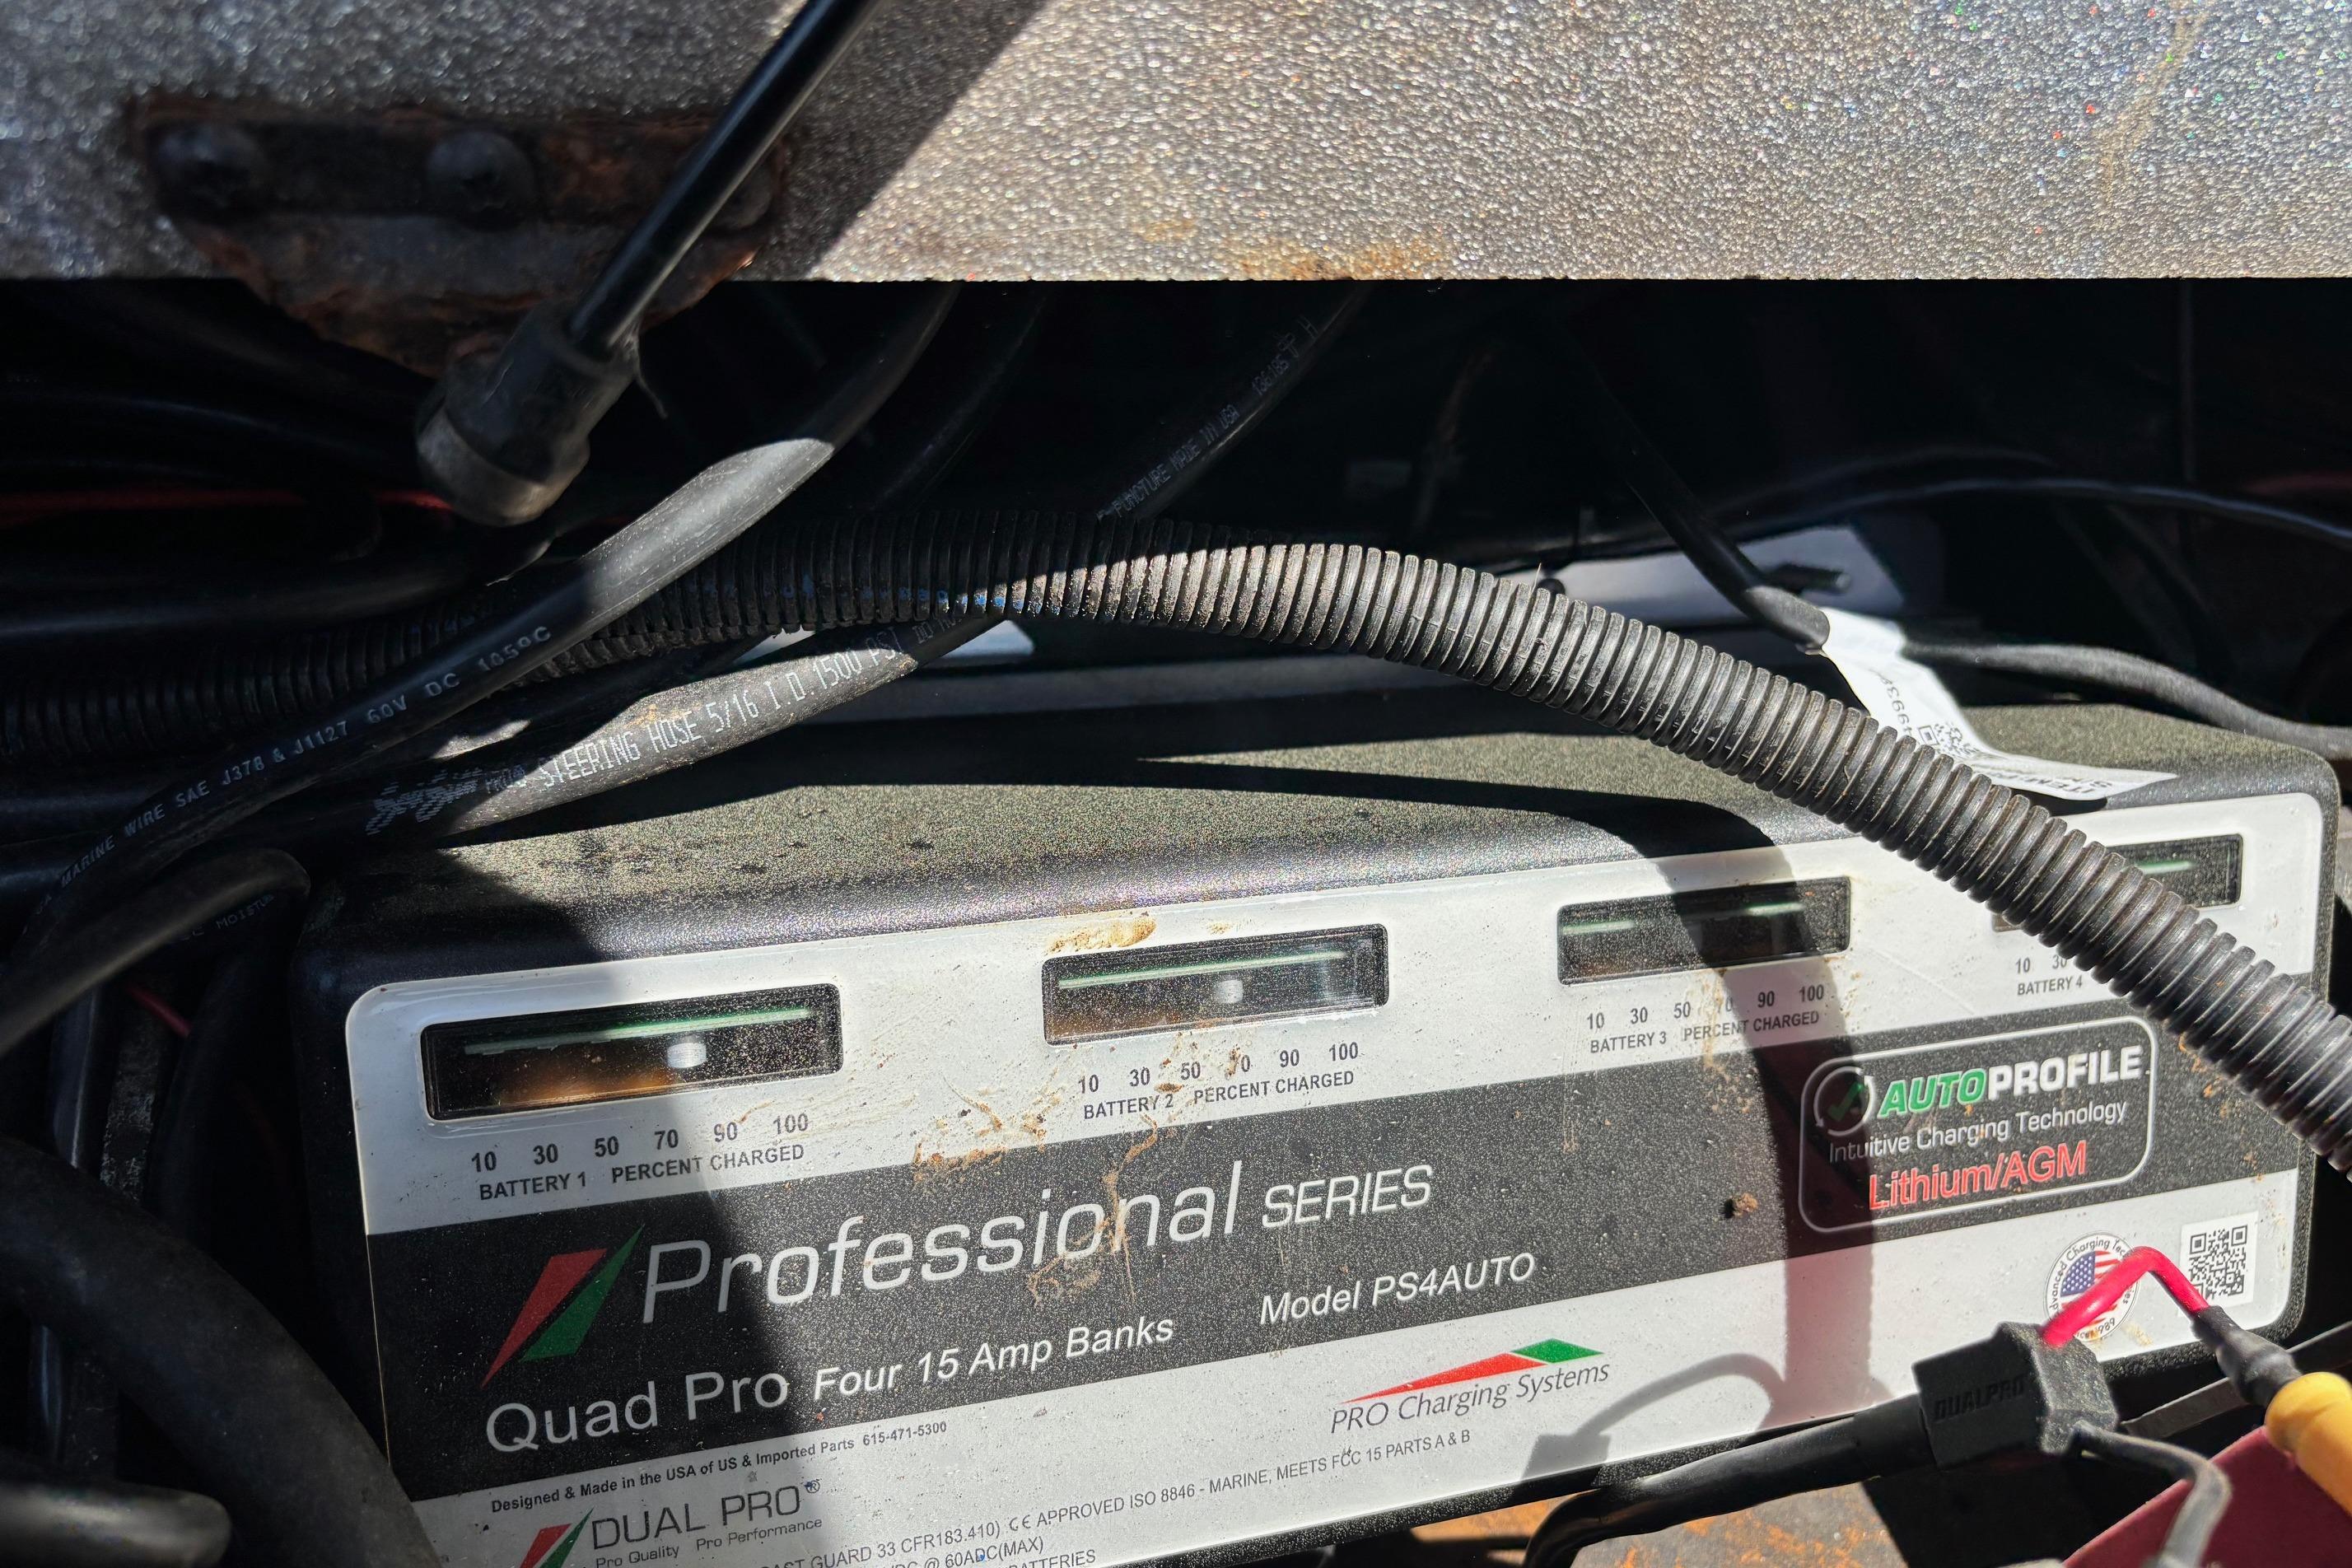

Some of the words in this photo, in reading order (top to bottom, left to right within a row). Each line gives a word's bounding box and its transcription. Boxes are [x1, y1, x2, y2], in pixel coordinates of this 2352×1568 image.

[538, 731, 642, 788] STEERING
[646, 710, 702, 754] HOSE
[705, 689, 759, 733] 5/16
[60, 834, 118, 887] MARINE
[124, 803, 166, 838] WIRE
[175, 780, 211, 809] SAE
[222, 755, 265, 786] J378
[271, 746, 287, 764] &
[292, 721, 349, 755] J1127
[366, 694, 408, 725] 60V
[424, 672, 461, 698] DC
[2015, 957, 2031, 973] 10
[2051, 951, 2068, 969] 30
[2017, 977, 2073, 996] BATTERY
[2075, 976, 2083, 989] 4
[1587, 1012, 1604, 1030] 10
[1631, 1006, 1648, 1024] 30
[1673, 1001, 1692, 1019] 50
[1757, 991, 1775, 1008] 90
[1799, 984, 1824, 1002] 100
[1590, 1032, 1656, 1053] BATTERY
[1659, 1031, 1667, 1044] 3
[1683, 1020, 1748, 1043] PERCENT
[1753, 1010, 1819, 1032] CHARGED
[1078, 1074, 1099, 1094] 10
[1129, 1068, 1151, 1087] 30
[1180, 1062, 1201, 1081] 50
[1280, 1049, 1300, 1068] 90
[1328, 1041, 1359, 1062] 100
[1083, 1094, 1160, 1120] BATTERY
[1164, 1094, 1174, 1108] 2
[1194, 1080, 1271, 1104] PERCENT
[1275, 1071, 1355, 1094] CHARGED
[471, 1151, 497, 1173] 10
[533, 1143, 558, 1165] 30
[595, 1136, 619, 1157] 50
[654, 1130, 679, 1150] 70
[713, 1122, 739, 1143] 90
[772, 1113, 809, 1136] 100
[1829, 1132, 1911, 1164] Intuitive
[1916, 1118, 2009, 1151] Charging
[2015, 1099, 2127, 1133] Technology
[479, 1173, 571, 1201] BATTERY
[577, 1171, 586, 1187] 1
[612, 1156, 702, 1184] PERCENT
[711, 1144, 805, 1171] CHARGED
[1869, 1139, 2088, 1211] Lithium/AGM
[642, 1160, 1243, 1323] Professional
[1261, 1164, 1434, 1230] SERIES
[2066, 1236, 2110, 1261] Charging
[1259, 1283, 1360, 1325] Model
[1371, 1252, 1536, 1304] PS4AUTO
[486, 1387, 658, 1454] Quad
[684, 1371, 789, 1421] Pro
[814, 1361, 903, 1401] Four
[917, 1348, 959, 1384] 15
[968, 1339, 1052, 1376] Amp
[1066, 1318, 1174, 1359] Banks
[1330, 1402, 1389, 1434] PRO
[1398, 1383, 1510, 1421] Charging
[1516, 1364, 1610, 1402] Systems
[492, 1489, 560, 1512] Designed
[565, 1486, 575, 1498] &
[581, 1480, 618, 1496] Made
[622, 1477, 635, 1488] in
[640, 1472, 661, 1486] the
[666, 1467, 697, 1481] USA
[700, 1462, 714, 1475] of
[718, 1457, 737, 1471] US
[742, 1454, 752, 1468] &
[756, 1444, 816, 1466] Imported
[820, 1438, 855, 1454] Parts
[862, 1421, 947, 1447] 615-471-5300
[592, 1503, 706, 1550] DUAL
[811, 1547, 871, 1568] GUARD
[877, 1541, 895, 1557] 33
[901, 1520, 1000, 1553] CFR183.410)
[1037, 1497, 1124, 1527] APPROVED
[1130, 1491, 1156, 1509] ISO
[1161, 1483, 1195, 1503] 8846
[1210, 1469, 1272, 1494] MARINE,
[1276, 1458, 1327, 1481] MEETS
[1332, 1451, 1361, 1469] FCC
[1365, 1447, 1381, 1462] 15
[1386, 1437, 1431, 1458] PARTS
[1435, 1435, 1444, 1449] A
[1449, 1432, 1457, 1445] &
[1461, 1430, 1471, 1443] B
[596, 1556, 623, 1568] Pro
[629, 1546, 679, 1564] Quality
[697, 1538, 721, 1552] Pro
[728, 1519, 822, 1546] Performance
[945, 1536, 1043, 1568] 60ADC(MAX)
